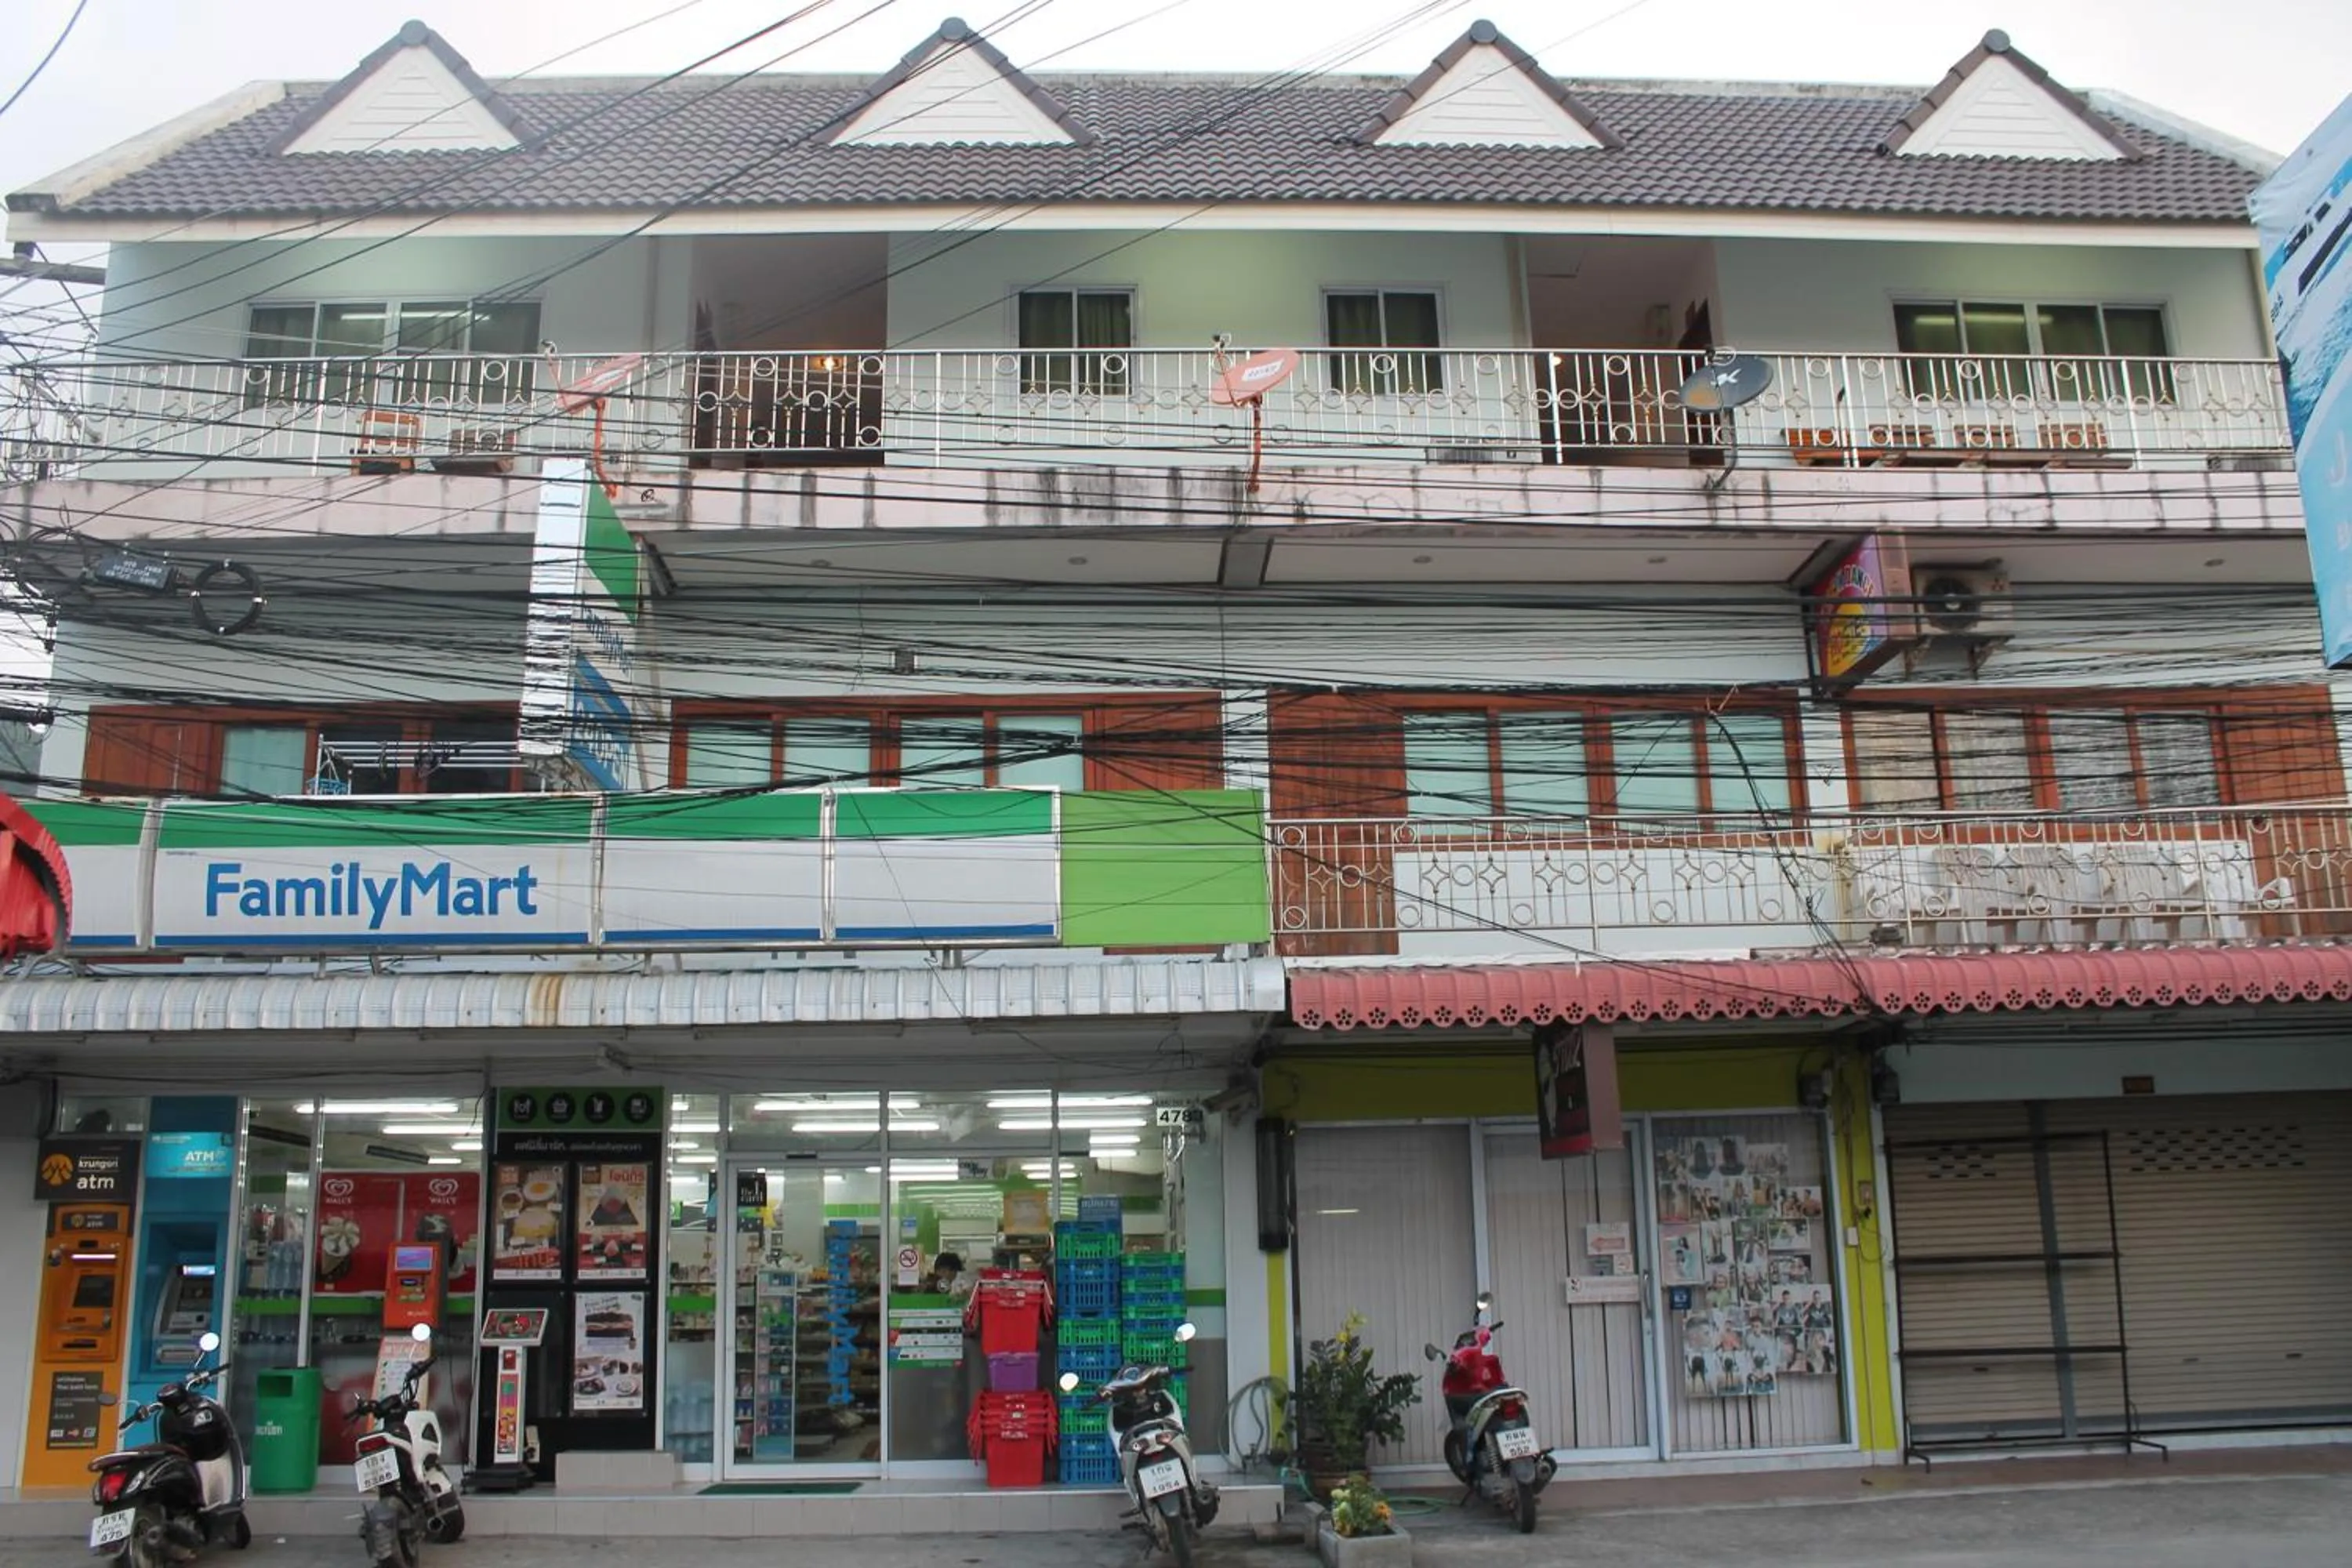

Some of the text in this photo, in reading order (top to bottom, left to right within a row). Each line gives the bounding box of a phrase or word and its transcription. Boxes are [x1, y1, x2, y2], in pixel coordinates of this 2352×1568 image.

[206, 862, 538, 930] FamilyMart
[185, 1150, 215, 1161] ATM
[77, 1175, 114, 1189] atm
